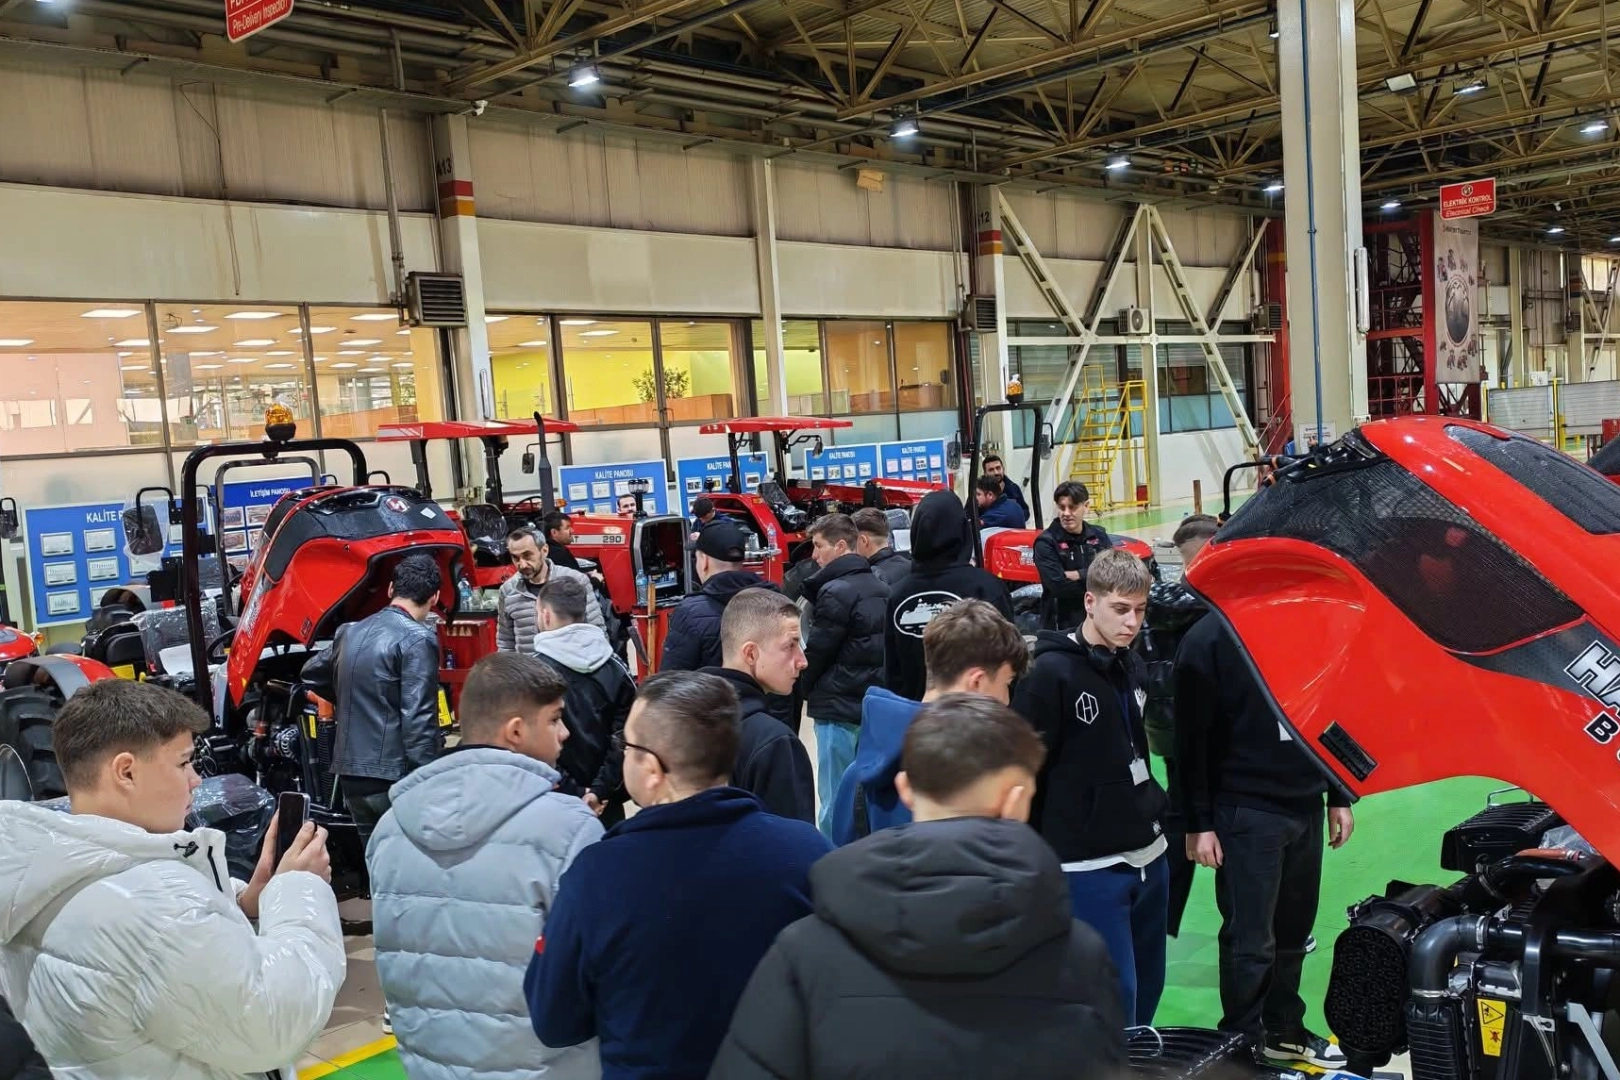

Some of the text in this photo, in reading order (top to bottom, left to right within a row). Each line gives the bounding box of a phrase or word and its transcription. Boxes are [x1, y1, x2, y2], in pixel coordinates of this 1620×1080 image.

[232, 10, 262, 34] Pre-Delivery
[262, 0, 288, 19] Inspection
[594, 469, 634, 479] KALİTE PANOSU
[86, 508, 117, 523] KALİTE
[602, 535, 622, 544] 290
